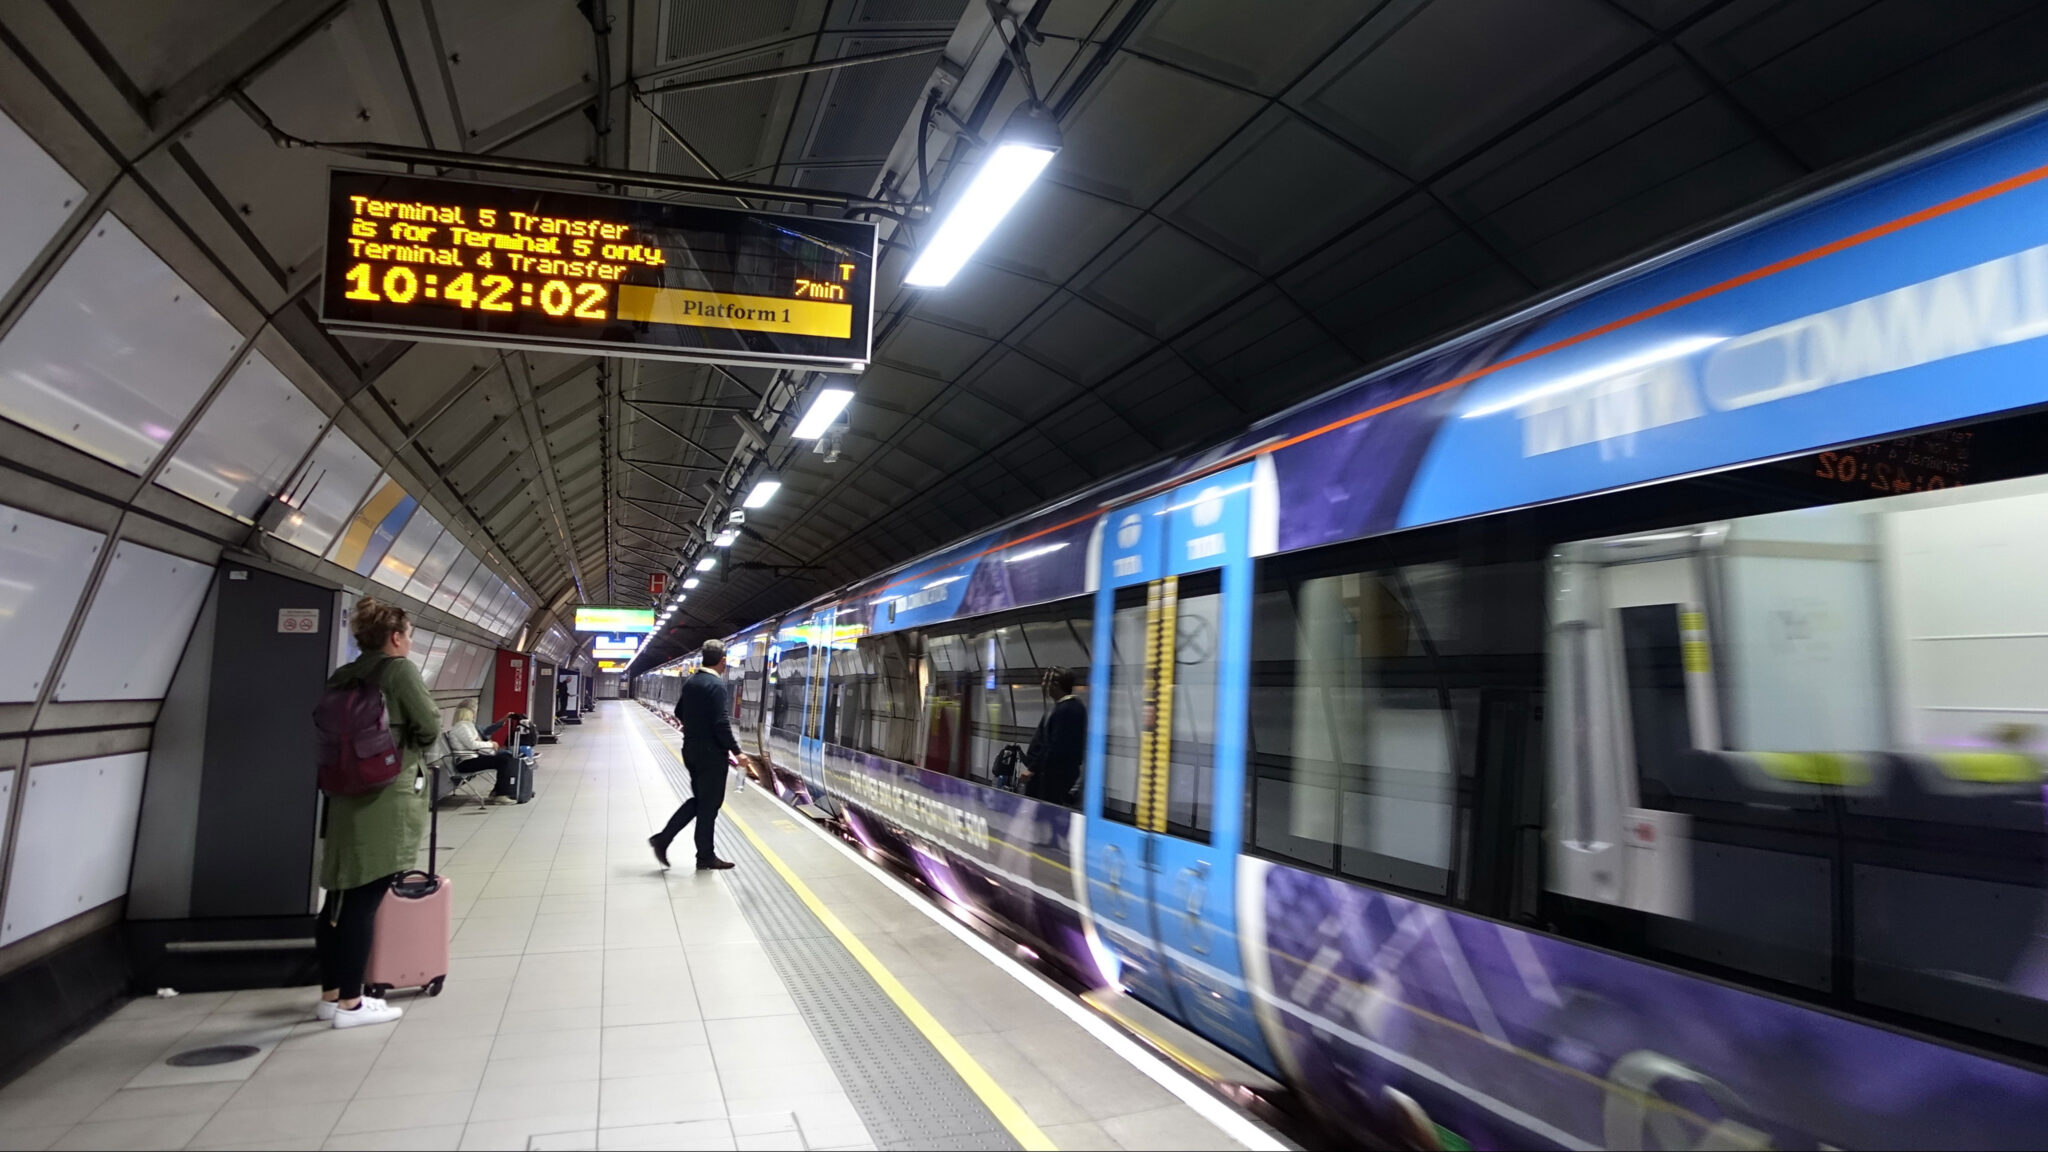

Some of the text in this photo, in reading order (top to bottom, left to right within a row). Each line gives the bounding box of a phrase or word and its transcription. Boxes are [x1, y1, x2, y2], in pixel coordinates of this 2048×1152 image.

[350, 195, 629, 240] Terminal 5 Transfer
[347, 237, 844, 300] Terminal 4 Transfer 7min
[352, 217, 378, 238] is
[390, 221, 437, 242] for
[449, 226, 562, 255] Terminal
[572, 238, 594, 257] 5
[838, 263, 856, 281] T
[344, 262, 608, 320] 10:42:02
[683, 299, 791, 323] Platform 1
